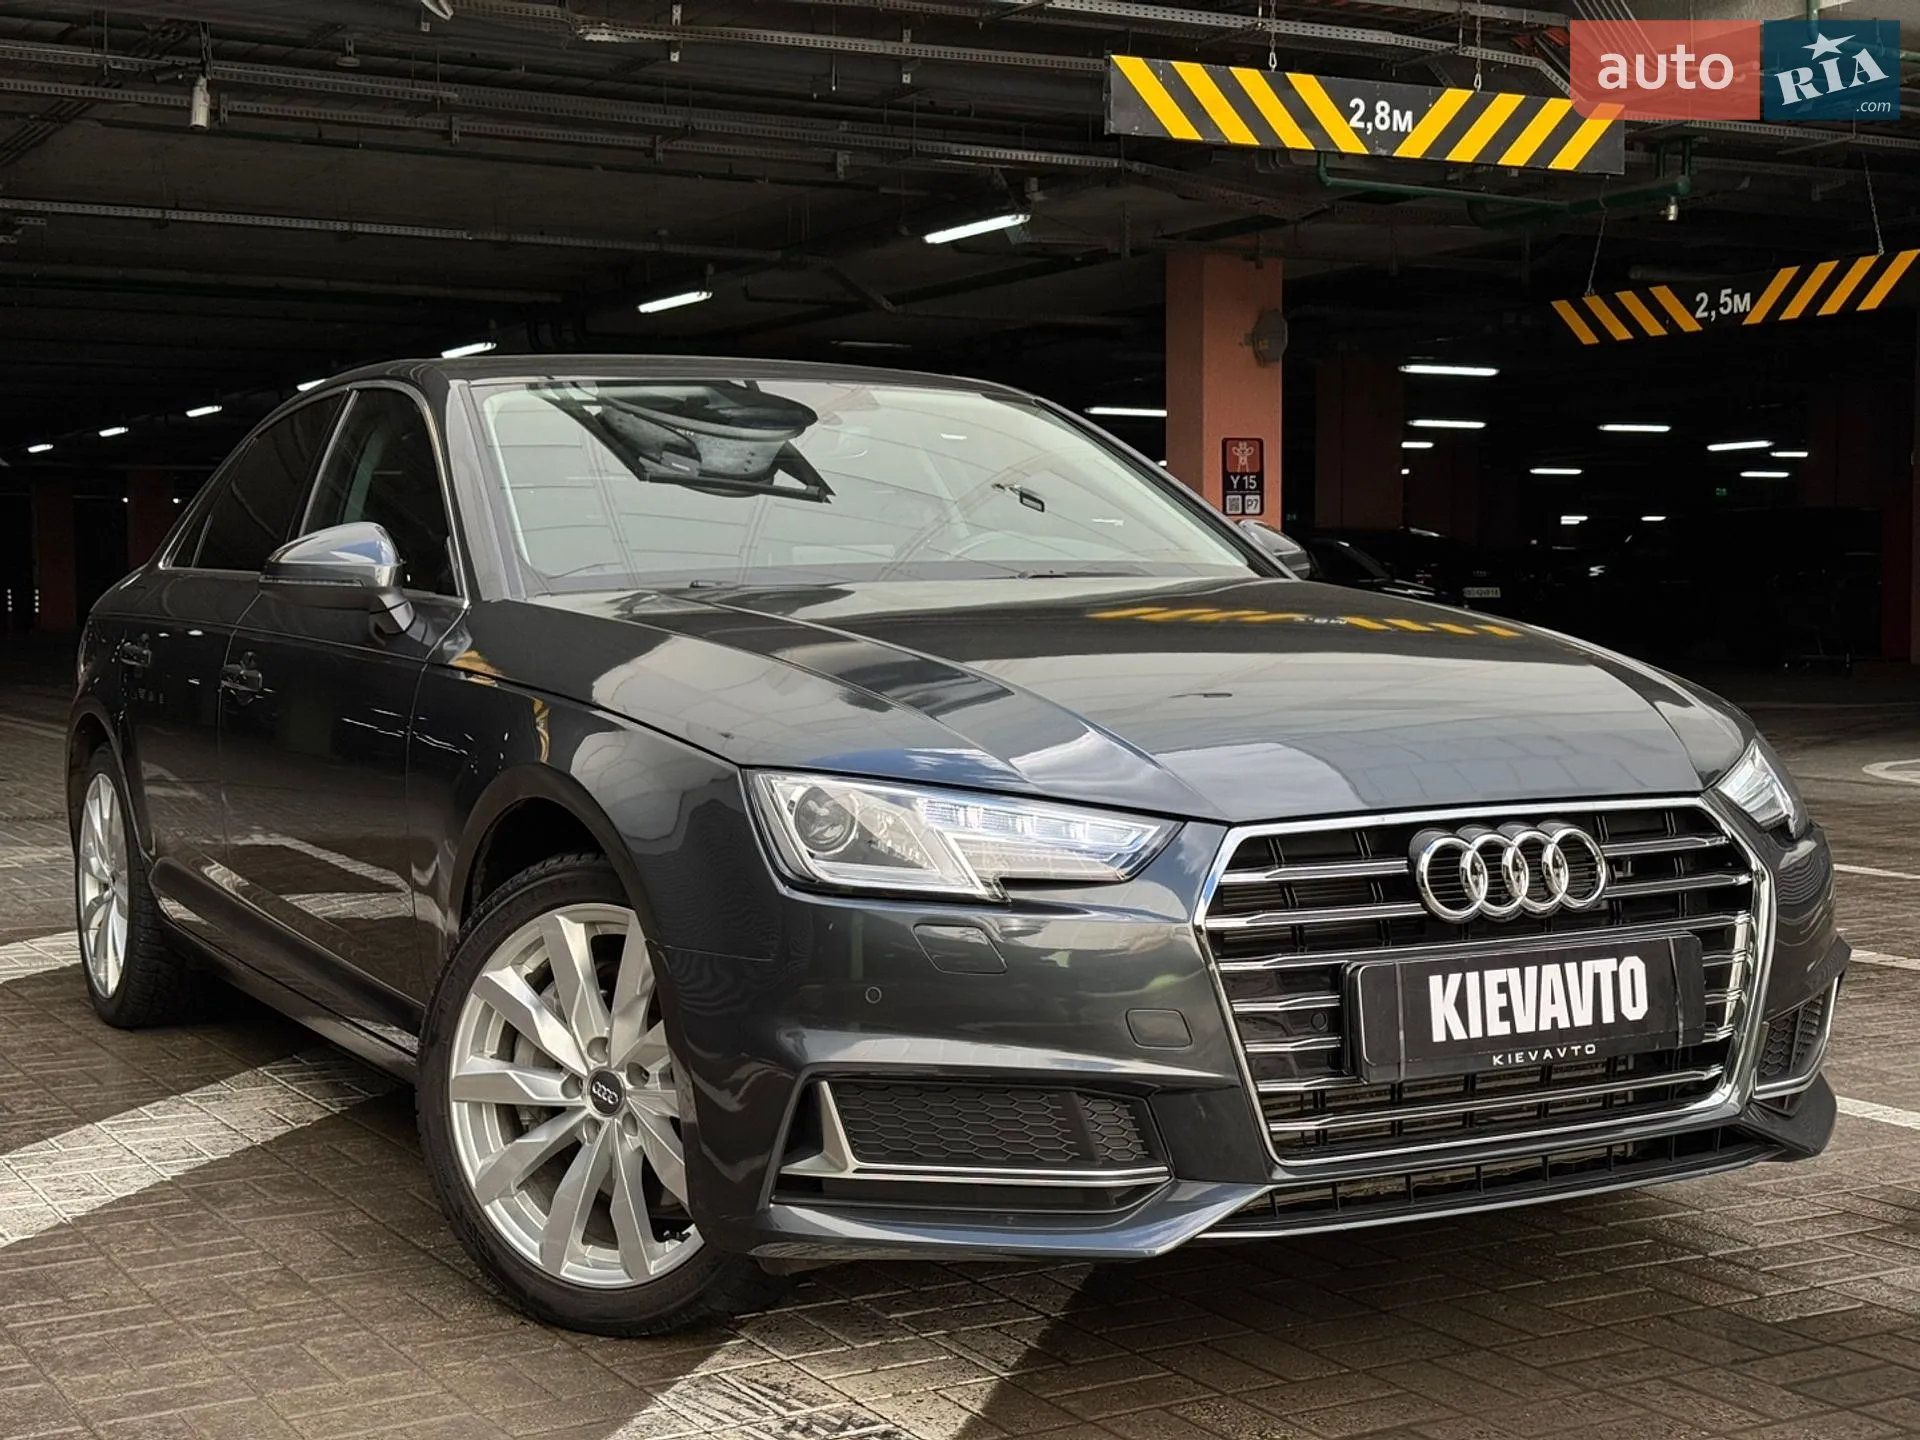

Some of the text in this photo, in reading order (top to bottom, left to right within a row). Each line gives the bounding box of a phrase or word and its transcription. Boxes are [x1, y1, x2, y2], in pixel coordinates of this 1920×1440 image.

[1246, 498, 1260, 510] P7
[1428, 956, 1648, 1043] KIEVAVTO
[1492, 1043, 1596, 1066] KIEVAVTO
